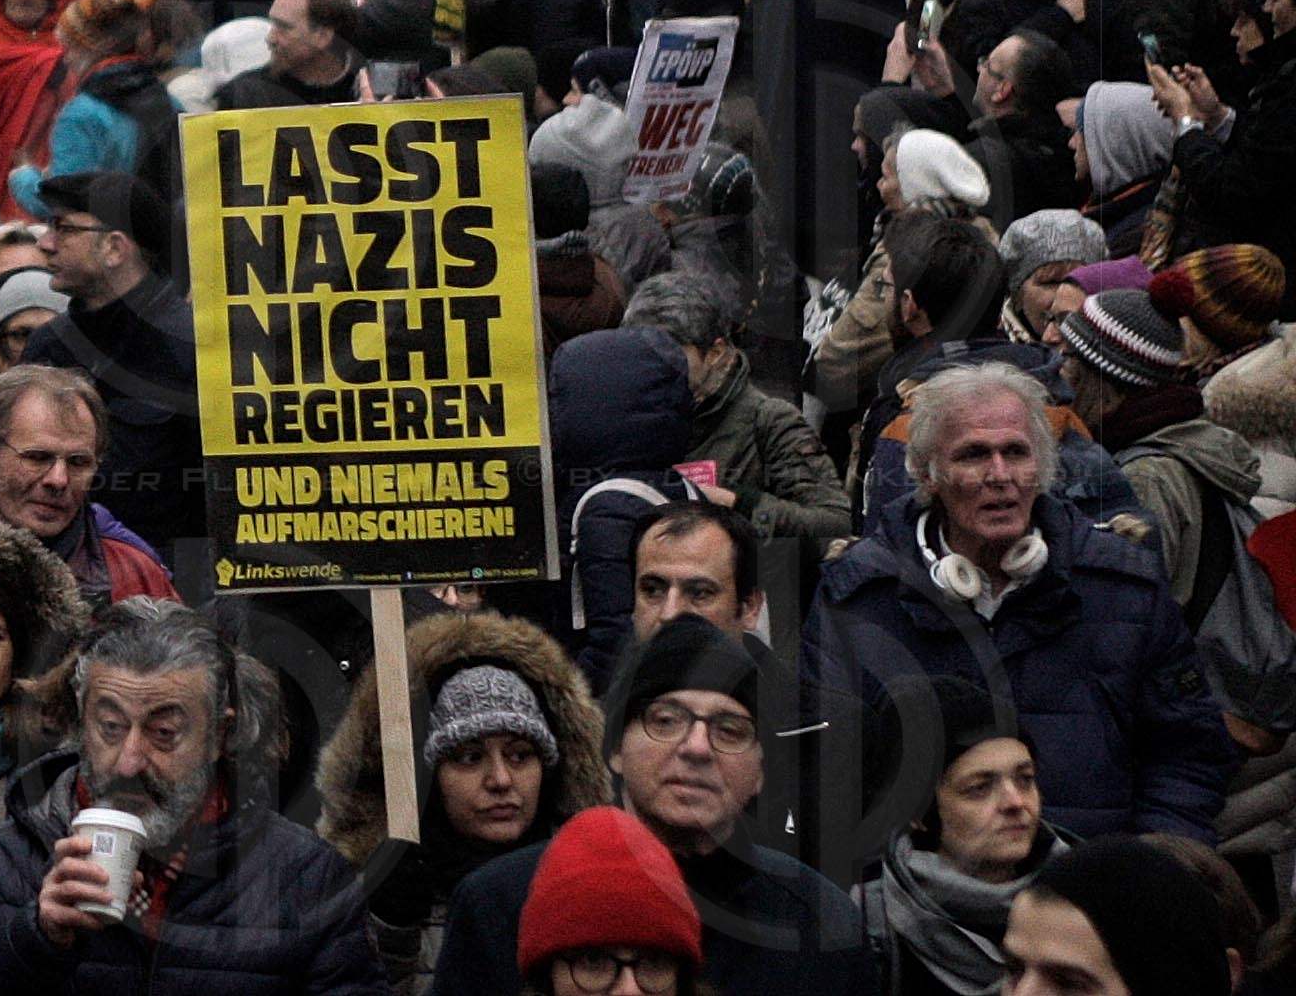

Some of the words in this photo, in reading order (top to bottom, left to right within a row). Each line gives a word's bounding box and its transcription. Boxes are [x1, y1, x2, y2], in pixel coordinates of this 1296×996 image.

[217, 118, 491, 207] LASST
[223, 205, 498, 295] NAZIS
[228, 295, 501, 386] NICHT
[232, 383, 506, 445] REGIEREN
[235, 466, 321, 507] UND
[331, 460, 509, 503] NIEMALS
[236, 507, 514, 544] AUFMARSCHIEREN!
[234, 562, 341, 580] Linkswende
